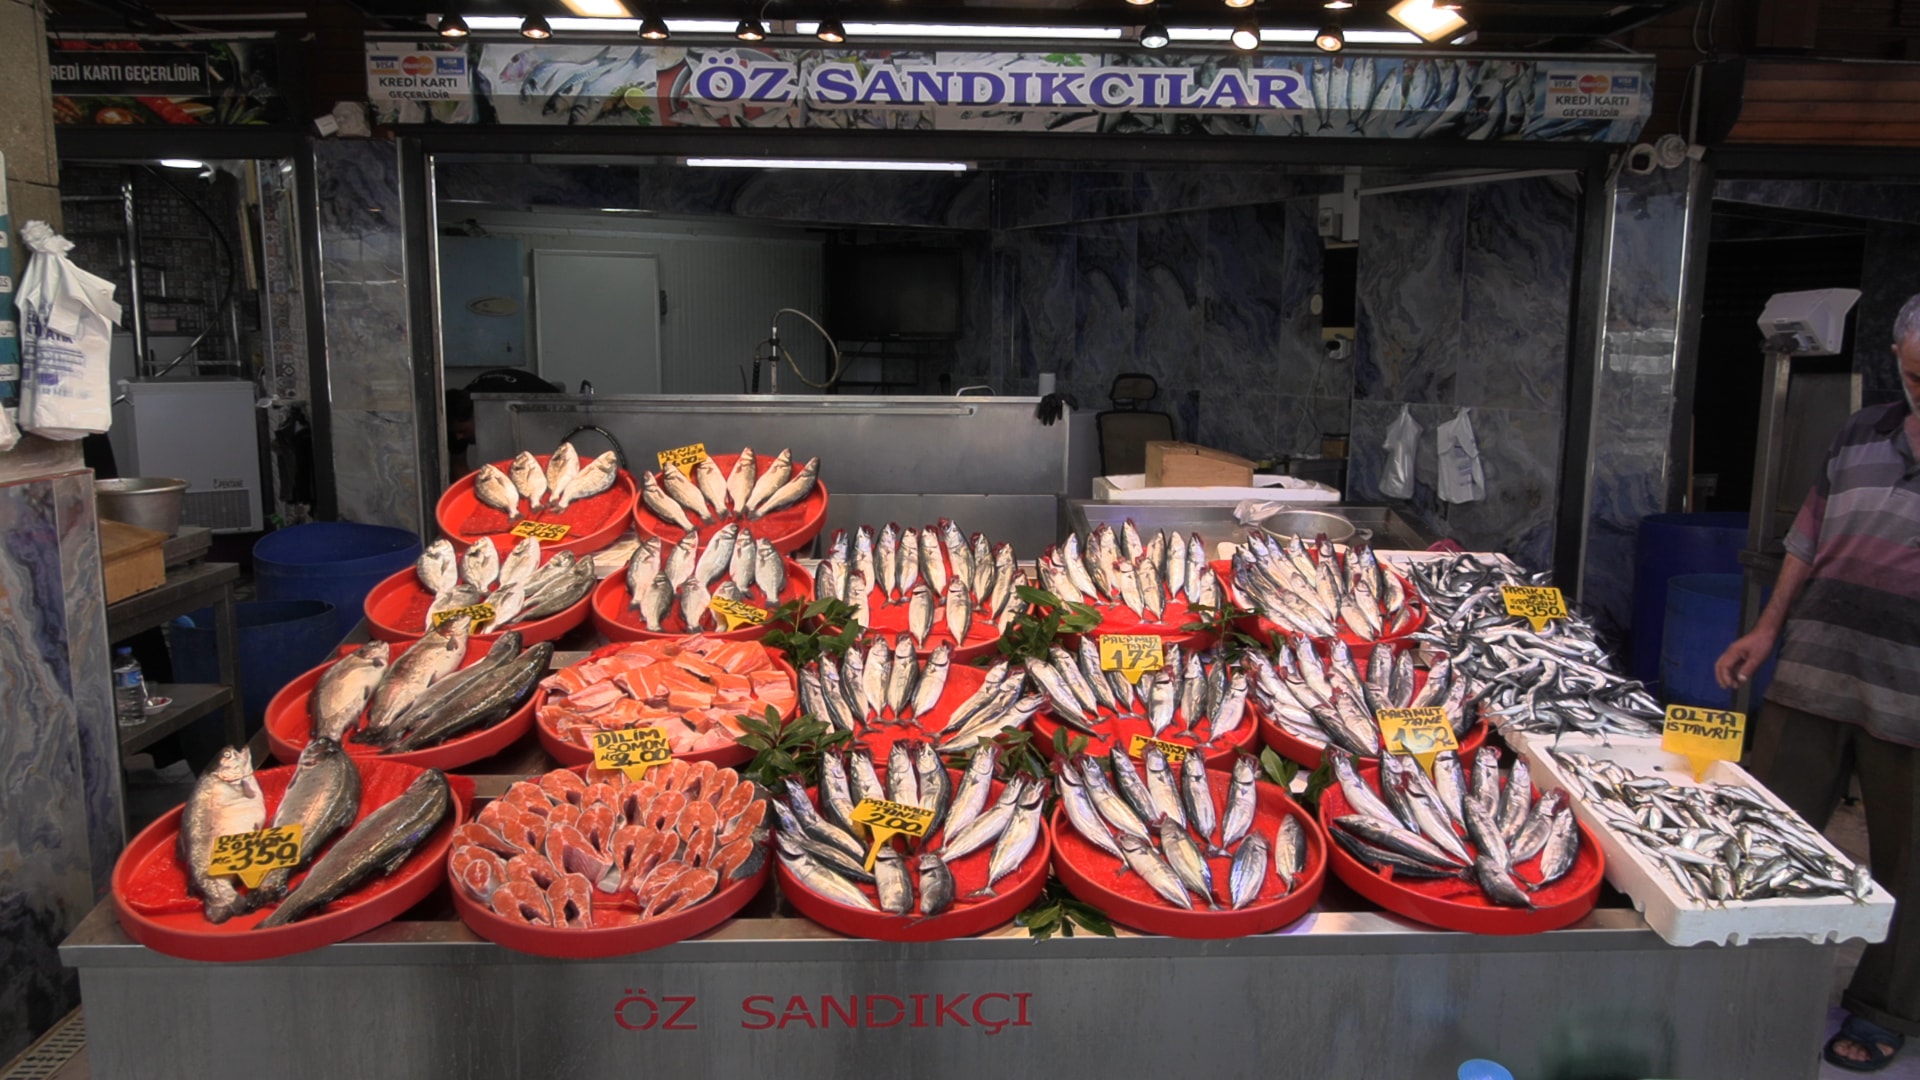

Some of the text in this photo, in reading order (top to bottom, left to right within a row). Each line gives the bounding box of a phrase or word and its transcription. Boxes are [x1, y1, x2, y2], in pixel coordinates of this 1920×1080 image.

[50, 63, 200, 84] REDİ KARTI GEÇERLİDİR
[379, 75, 458, 88] KREDİ KARTI
[696, 55, 1303, 109] ÖZ SANDIKCILAR
[388, 89, 450, 100] GEÇERLİDİR
[1555, 93, 1630, 107] KREDİ KARTI
[1562, 106, 1620, 118] GEÇERLİDİR
[1110, 648, 1161, 669] 175
[1670, 708, 1736, 727] OLTA
[606, 738, 667, 753] SOMON
[861, 812, 923, 832] 200
[229, 842, 299, 871] 350
[613, 987, 1033, 1036] ÖZ SANDIKÇI
